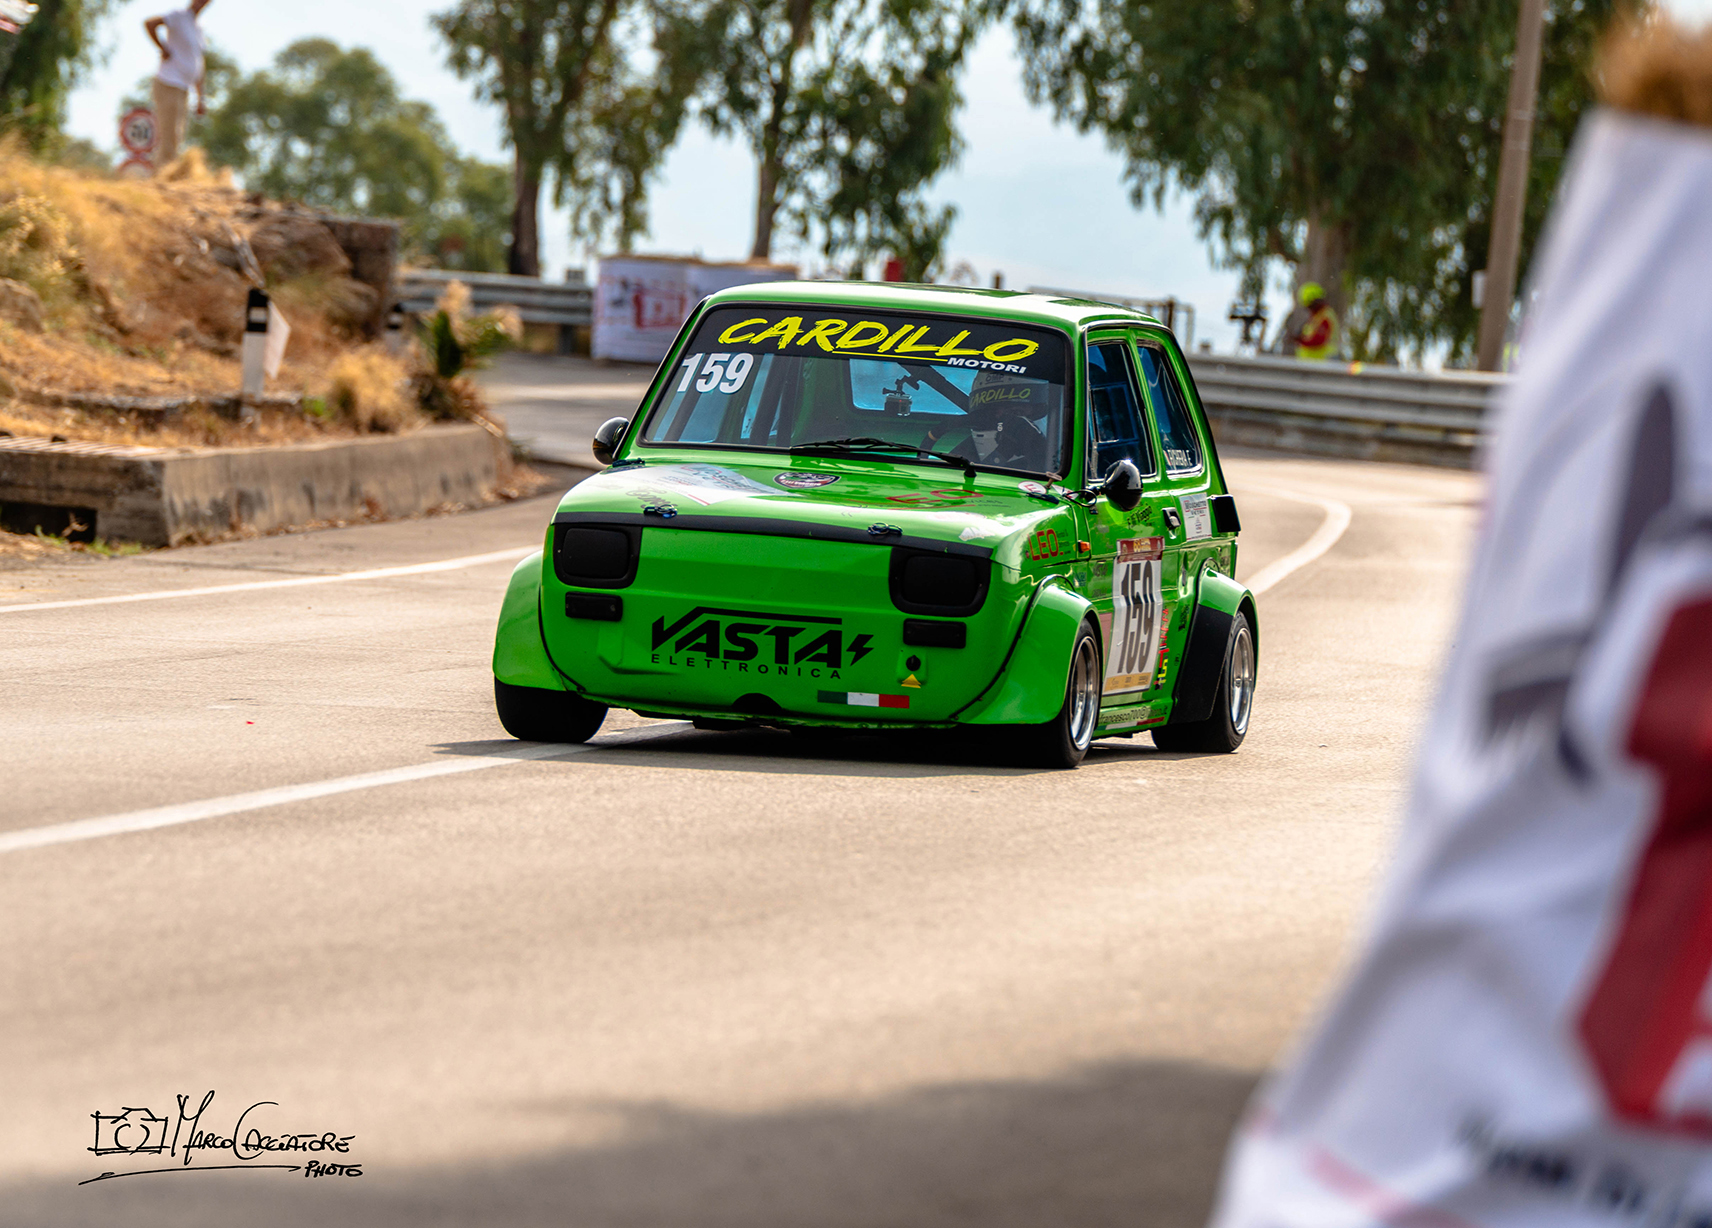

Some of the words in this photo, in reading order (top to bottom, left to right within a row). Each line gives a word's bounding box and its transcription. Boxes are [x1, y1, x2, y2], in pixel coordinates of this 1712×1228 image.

[718, 316, 1040, 361] CARDILLO
[676, 352, 754, 394] 159
[946, 356, 1028, 374] MOTORI
[651, 606, 842, 669] VASTA
[1117, 560, 1155, 674] 159
[651, 653, 842, 680] ELETTRONICA
